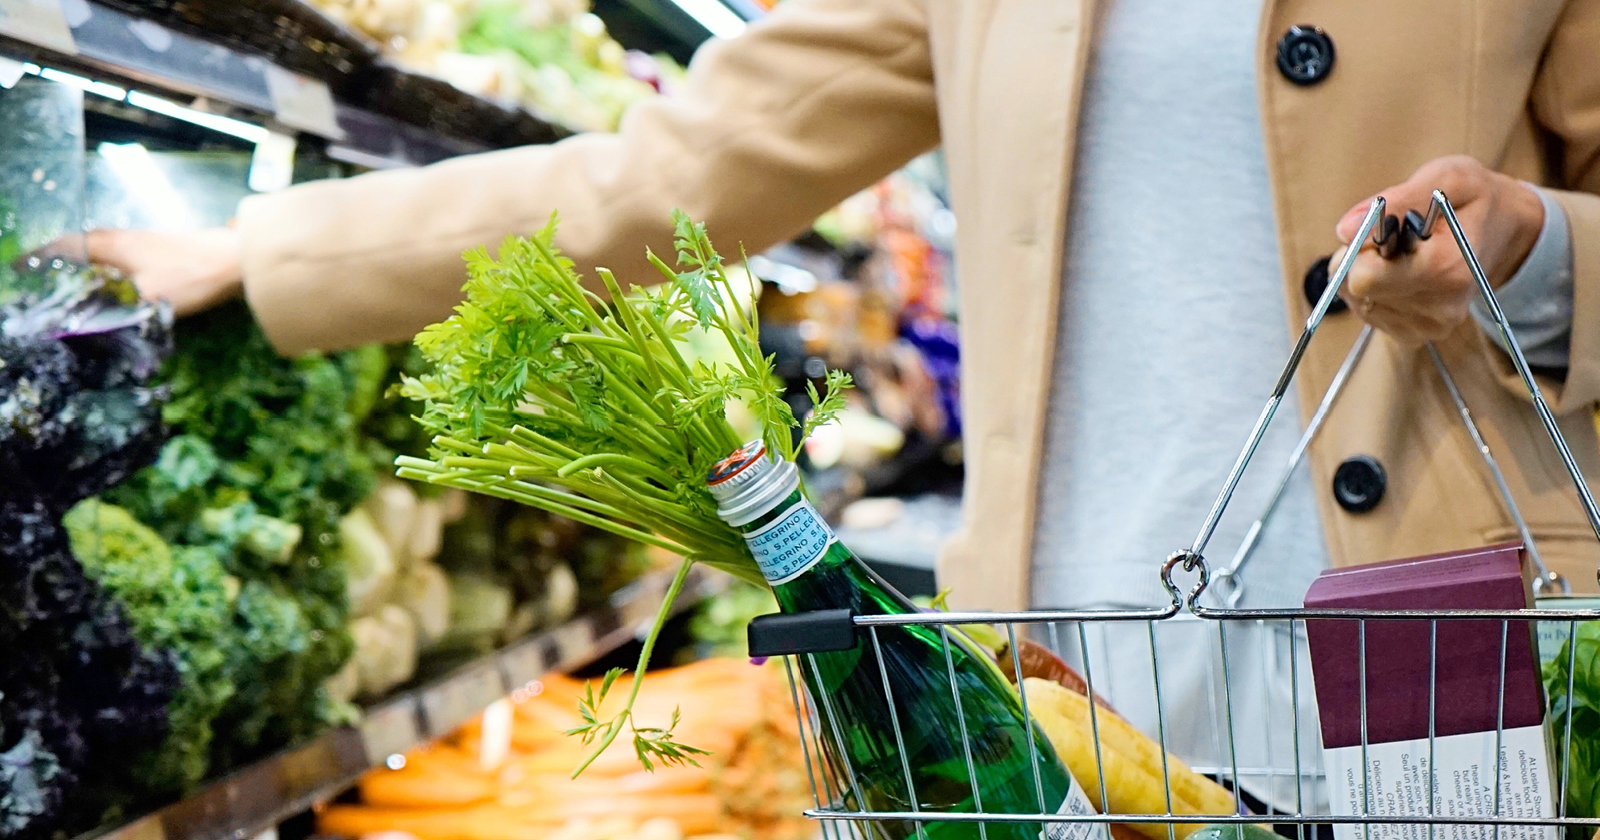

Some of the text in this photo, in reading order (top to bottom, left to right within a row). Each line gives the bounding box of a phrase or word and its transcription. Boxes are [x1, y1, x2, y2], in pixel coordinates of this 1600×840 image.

[1401, 753, 1411, 771] Seul
[1419, 757, 1428, 768] de
[1518, 749, 1530, 785] delicious
[1529, 757, 1537, 766] At
[1347, 767, 1355, 787] vous
[1372, 760, 1384, 796] Délicieux
[1378, 797, 1385, 808] au
[1404, 773, 1412, 784] un
[1411, 765, 1421, 784] avec
[1453, 770, 1463, 799] cheese
[1462, 769, 1471, 783] but
[1471, 764, 1480, 786] these
[1530, 767, 1540, 793] Lesley
[1350, 788, 1358, 798] ne
[1405, 785, 1416, 812] produit
[1415, 785, 1425, 805] soin,
[1464, 784, 1474, 806] really
[1504, 782, 1513, 796] her
[1514, 792, 1522, 806] are
[1434, 796, 1443, 816] Stow
[1457, 801, 1464, 809] or
[1474, 788, 1483, 815] unique
[1506, 797, 1515, 818] team
